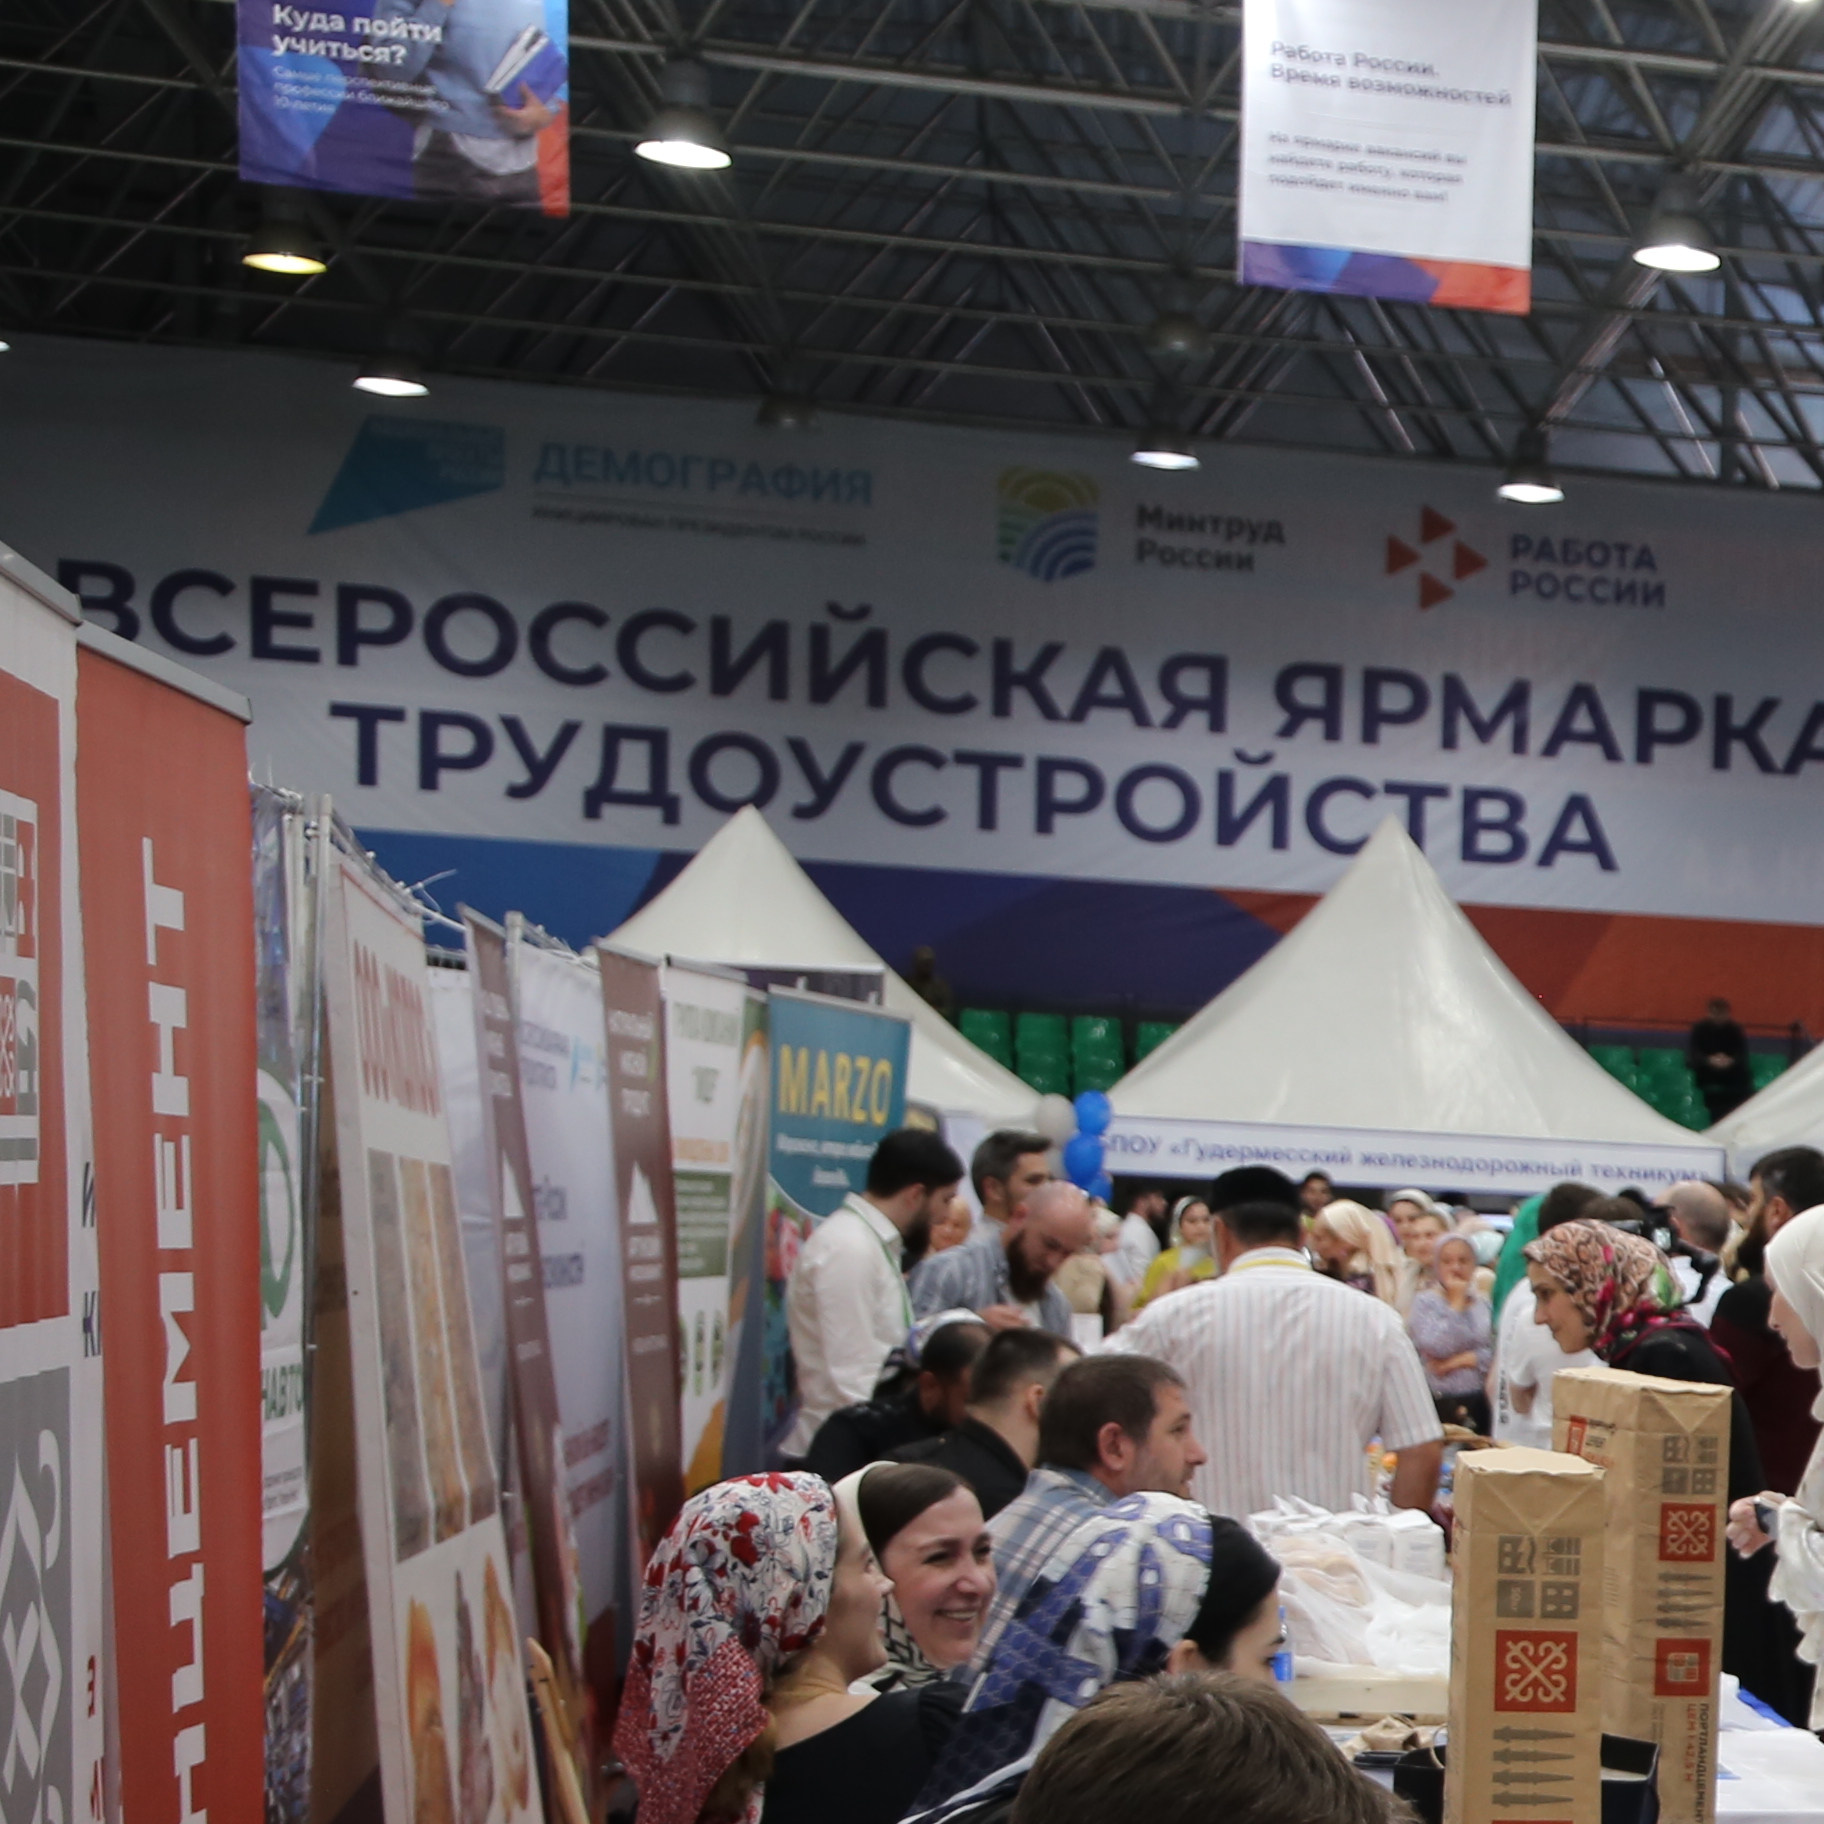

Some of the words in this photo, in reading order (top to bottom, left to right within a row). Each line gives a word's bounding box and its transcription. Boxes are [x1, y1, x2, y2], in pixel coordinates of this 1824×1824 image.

[272, 4, 345, 32] Куда
[353, 14, 443, 43] пойти
[271, 34, 408, 65] учиться?
[1271, 41, 1346, 66] Работа
[1353, 52, 1440, 77] России.
[1271, 63, 1341, 88] Время
[1348, 76, 1512, 105] возможностей
[533, 441, 873, 505] ДЕМОГРАФИЯ
[1135, 505, 1285, 545] Минтруд
[1135, 539, 1255, 573] России
[1511, 533, 1656, 571] РАБОТА
[1510, 570, 1665, 607] РОССИИ
[56, 558, 1229, 735] ВСЕРОССИЙСКАЯ
[328, 702, 1619, 873] ТРУДОУСТРОЙСТВА
[779, 1044, 893, 1127] MARZO
[1102, 1134, 1160, 1154] БПОУ
[1360, 1150, 1583, 1181] железнодорожный
[1695, 1703, 1709, 1824] ПОРТЛАНДЦЕМЕНТ
